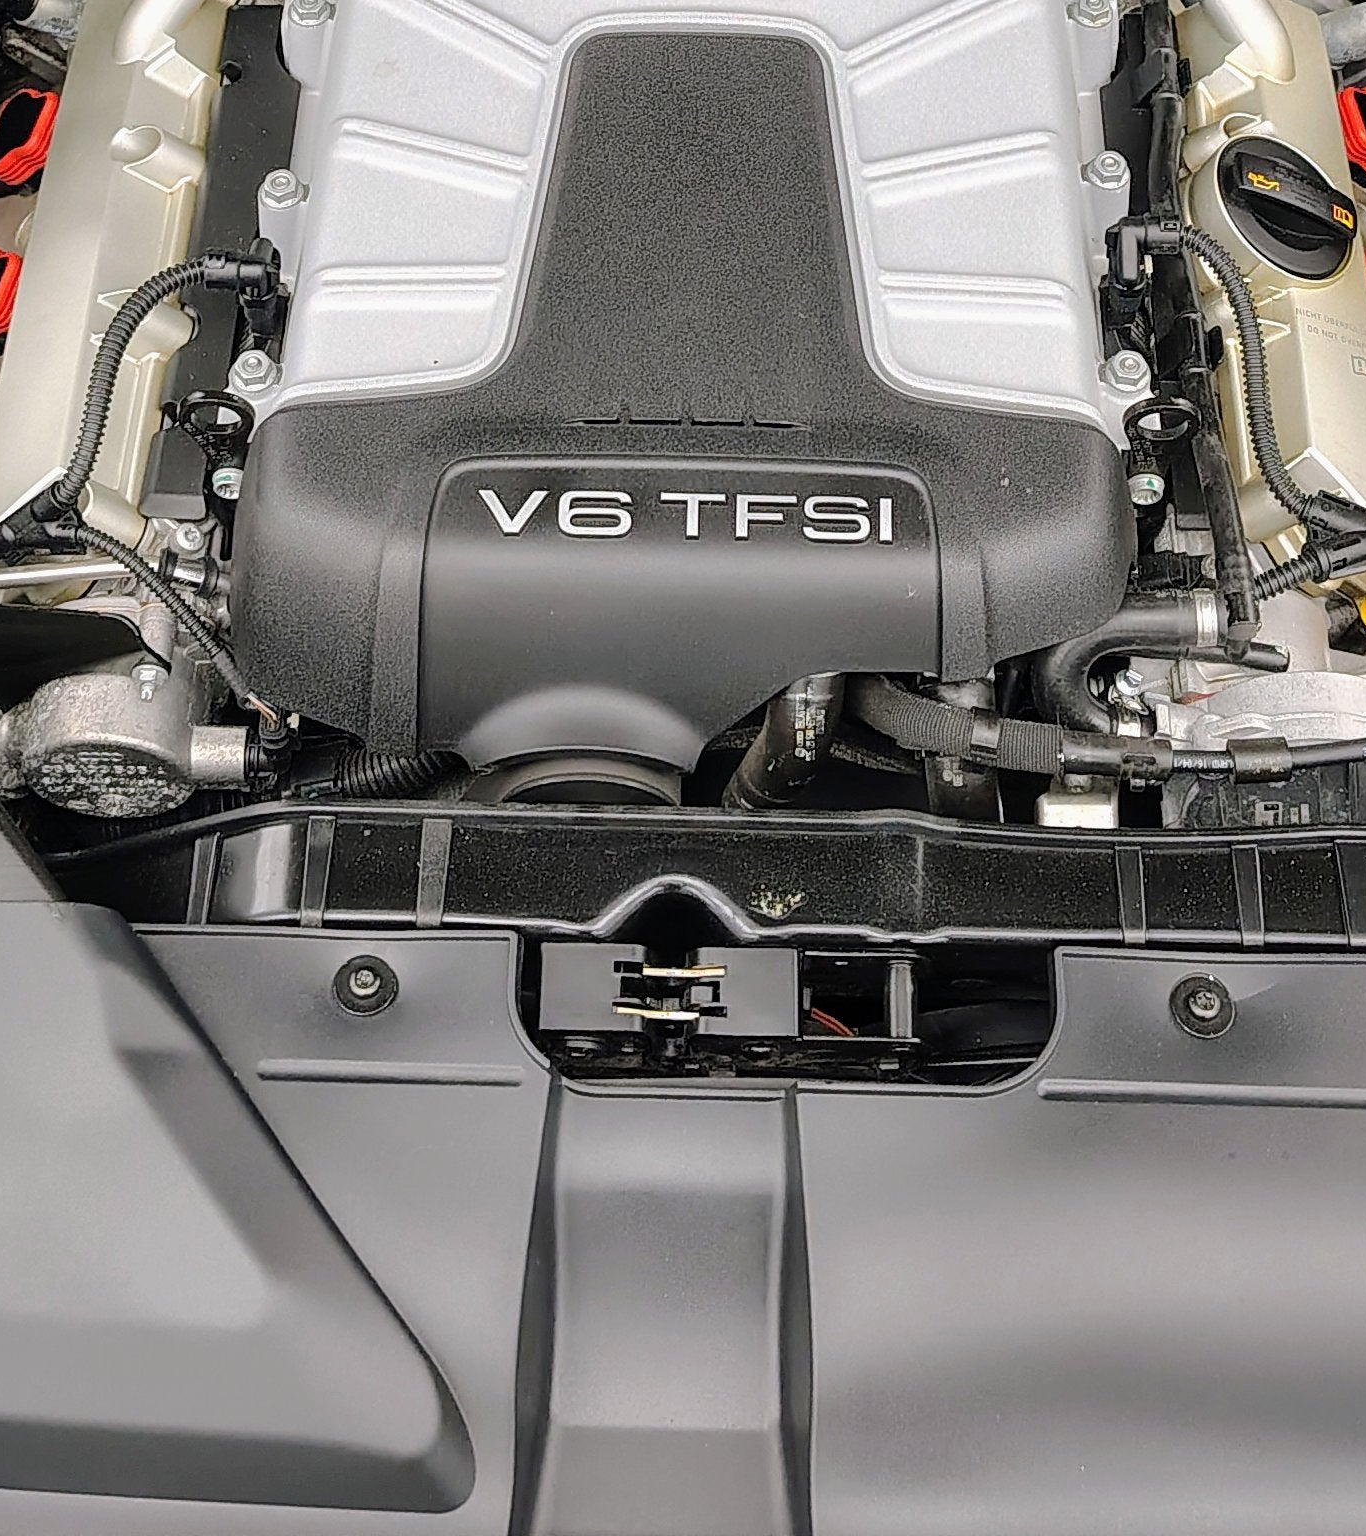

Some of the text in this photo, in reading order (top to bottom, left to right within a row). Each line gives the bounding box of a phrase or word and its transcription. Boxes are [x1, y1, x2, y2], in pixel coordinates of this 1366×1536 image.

[1295, 307, 1322, 321] NICHT
[1307, 324, 1320, 334] DO
[1322, 329, 1338, 341] NOT
[478, 488, 895, 545] V6 TFSI
